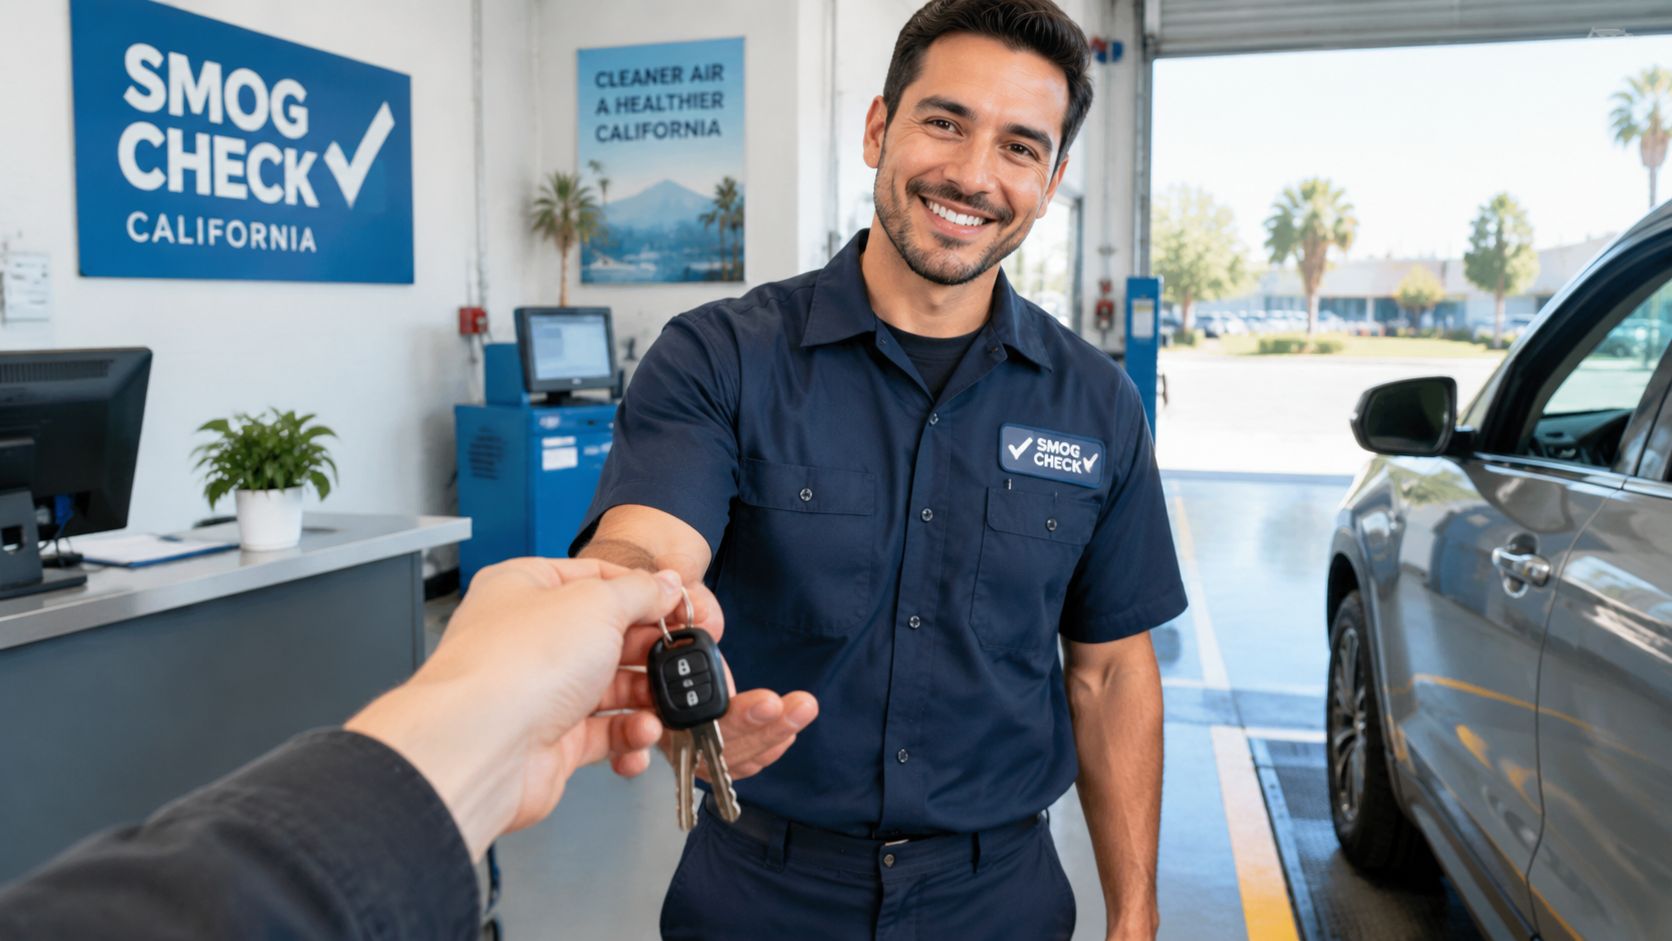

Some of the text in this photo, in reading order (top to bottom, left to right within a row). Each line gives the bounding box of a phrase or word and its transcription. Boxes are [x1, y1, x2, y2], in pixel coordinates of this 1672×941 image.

[594, 63, 725, 88] CLEANER AIR
[123, 42, 309, 140] SMOG
[595, 91, 725, 116] A HEALTHIER
[594, 119, 722, 143] CALIFORNIA
[117, 120, 320, 208] CHECK
[126, 210, 317, 253] CALIFORNIA
[1036, 437, 1081, 459] SMOG
[1033, 452, 1083, 474] CHECK
